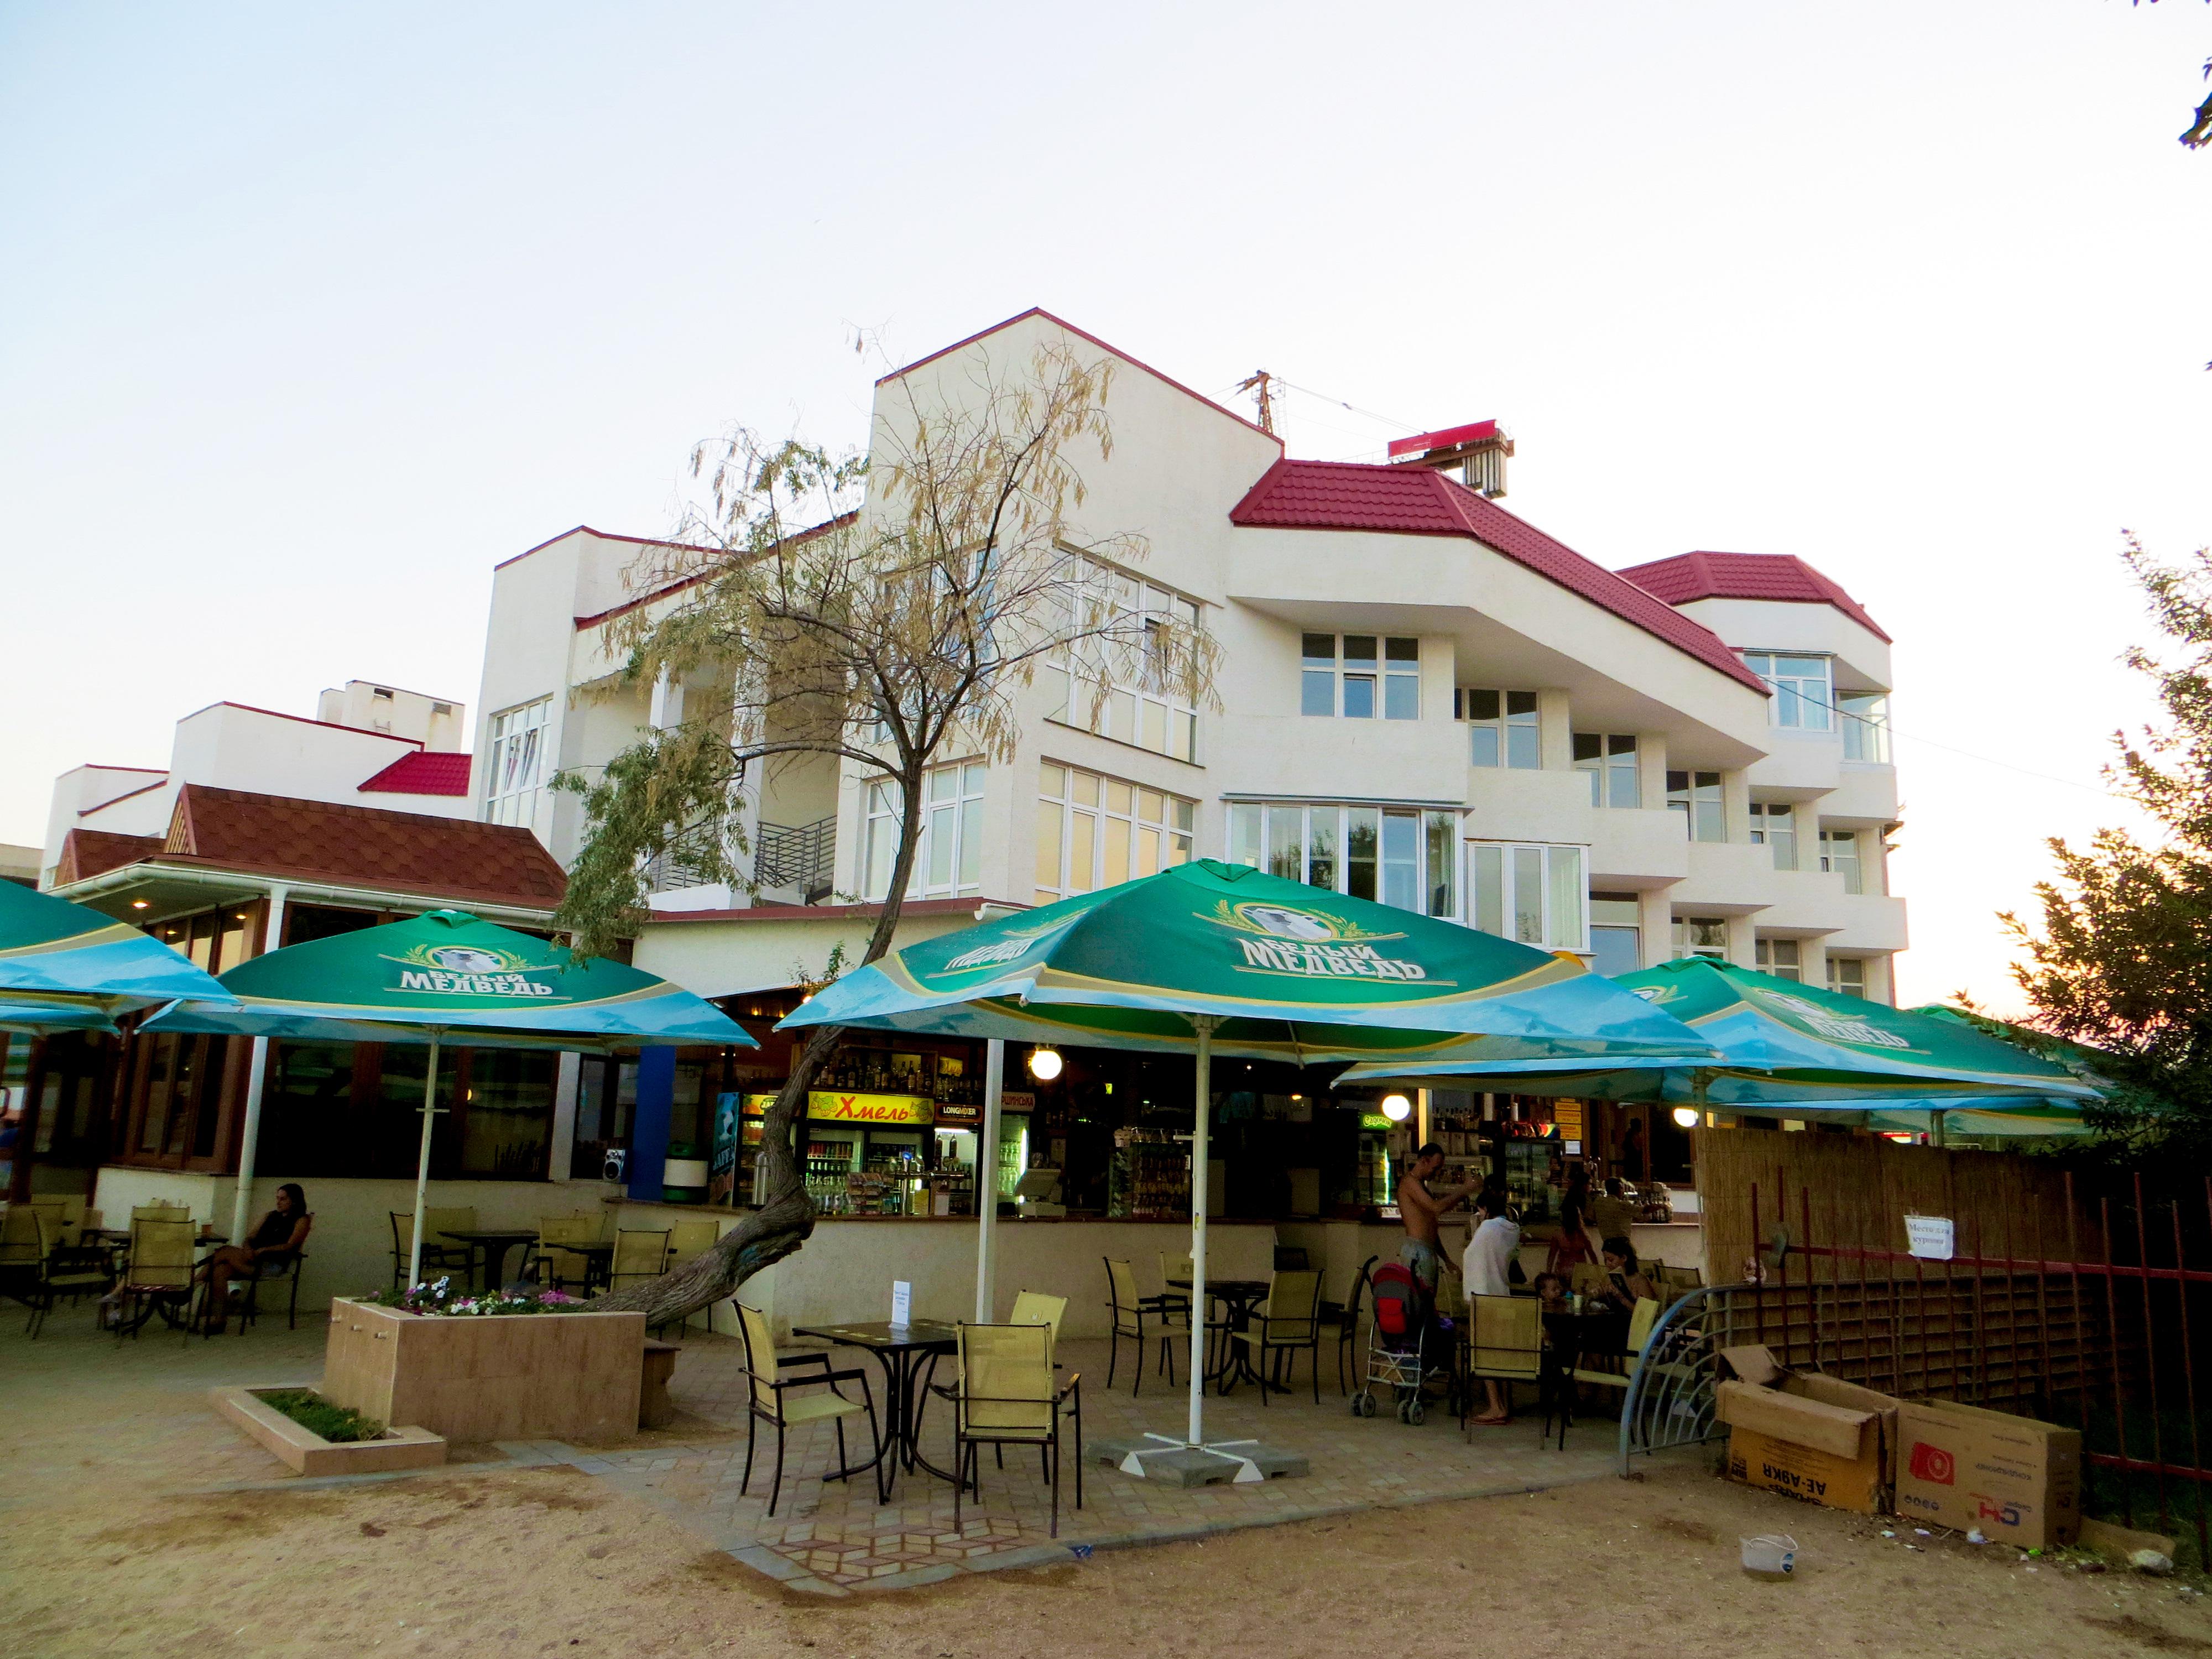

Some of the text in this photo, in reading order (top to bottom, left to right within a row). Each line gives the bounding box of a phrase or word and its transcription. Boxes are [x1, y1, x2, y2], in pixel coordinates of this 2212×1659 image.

[1237, 938, 1426, 980] МЕДВЕДЬ
[1260, 938, 1383, 961] БЕЛЫЙ
[399, 971, 554, 995] МЕДВЕДЬ
[429, 970, 525, 983] БЕЛЫЙ
[1796, 1015, 1910, 1047] МЕДВЕДЬ
[835, 1095, 910, 1121] Хмель
[943, 1106, 976, 1115] LONGMIXER
[1001, 1094, 1034, 1107] РШИНСЬКА
[1909, 1224, 1933, 1233] Место
[1762, 1462, 1827, 1496] AE-A9KR
